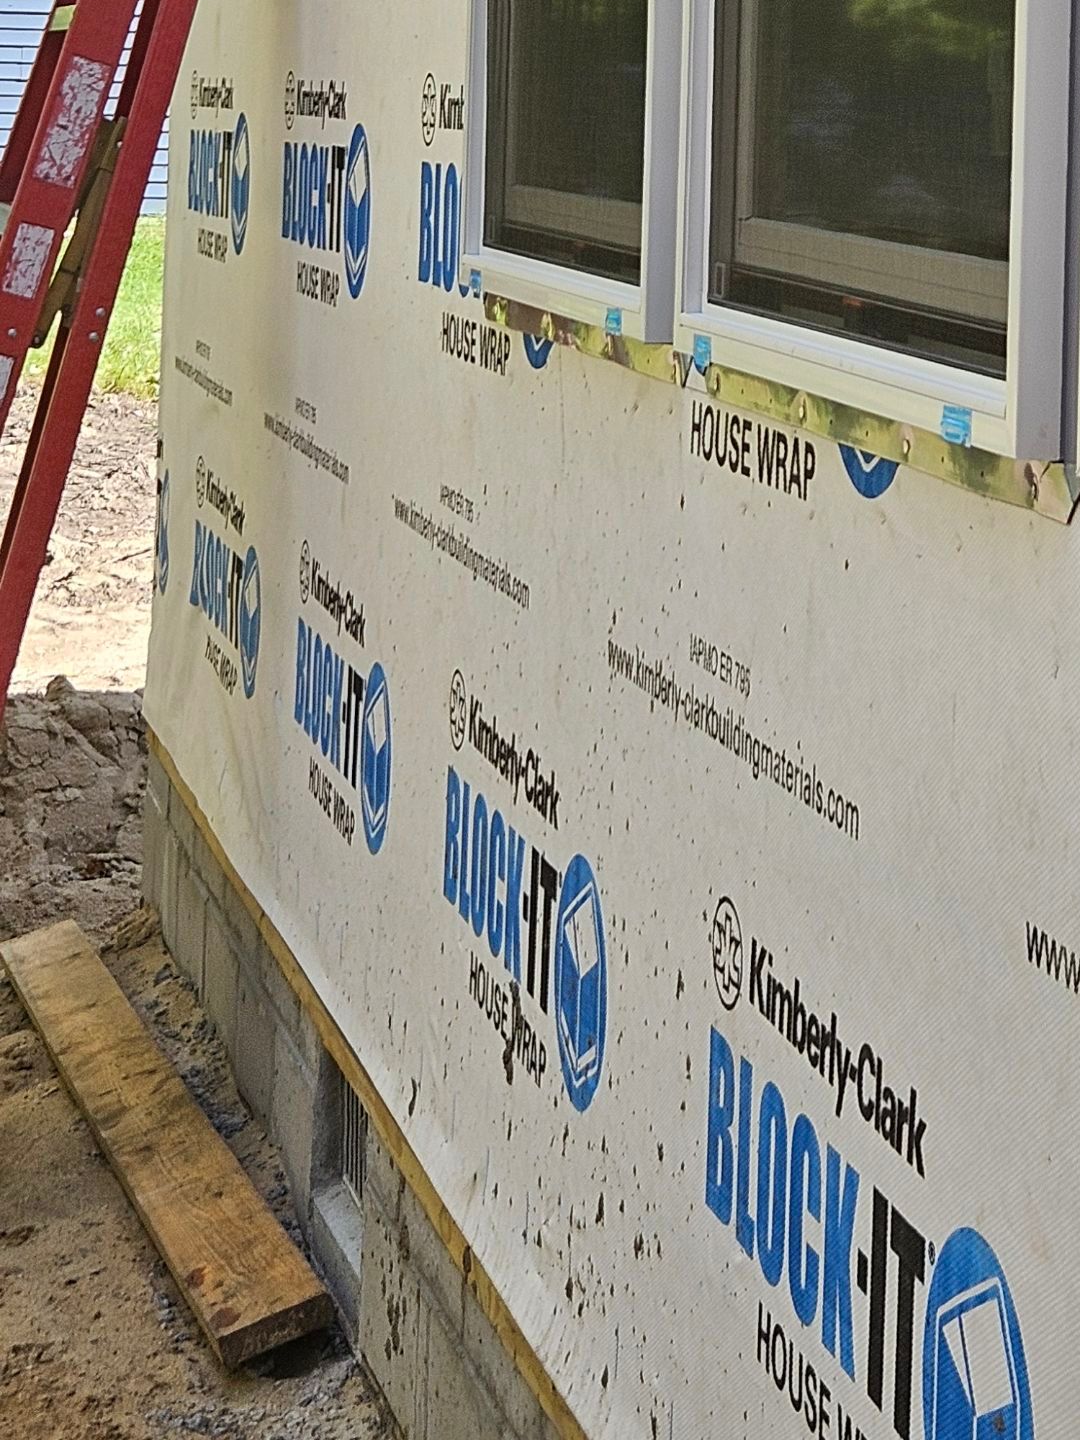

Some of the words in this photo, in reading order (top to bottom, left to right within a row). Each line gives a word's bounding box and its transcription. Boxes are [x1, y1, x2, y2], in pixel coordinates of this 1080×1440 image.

[281, 141, 346, 253] BLOCK-IT
[441, 311, 477, 364] HOUSE
[479, 325, 512, 377] WRAP
[690, 400, 753, 479] HOUSE
[756, 422, 816, 502] WRAP
[311, 557, 367, 649] Kimberly-Clark
[294, 615, 364, 791] BLOCK-IT
[468, 693, 560, 831] Kimberly-Clark
[308, 756, 332, 820] HOUSE
[333, 790, 356, 847] WRAP
[443, 764, 558, 1016] BLOCK-IT
[469, 950, 508, 1042] HOUSE
[511, 1000, 546, 1089] WRAP
[749, 935, 927, 1180] Kimberly-Clark
[705, 1023, 927, 1440] BLOCK-IT
[756, 1300, 832, 1440] HOUSE
